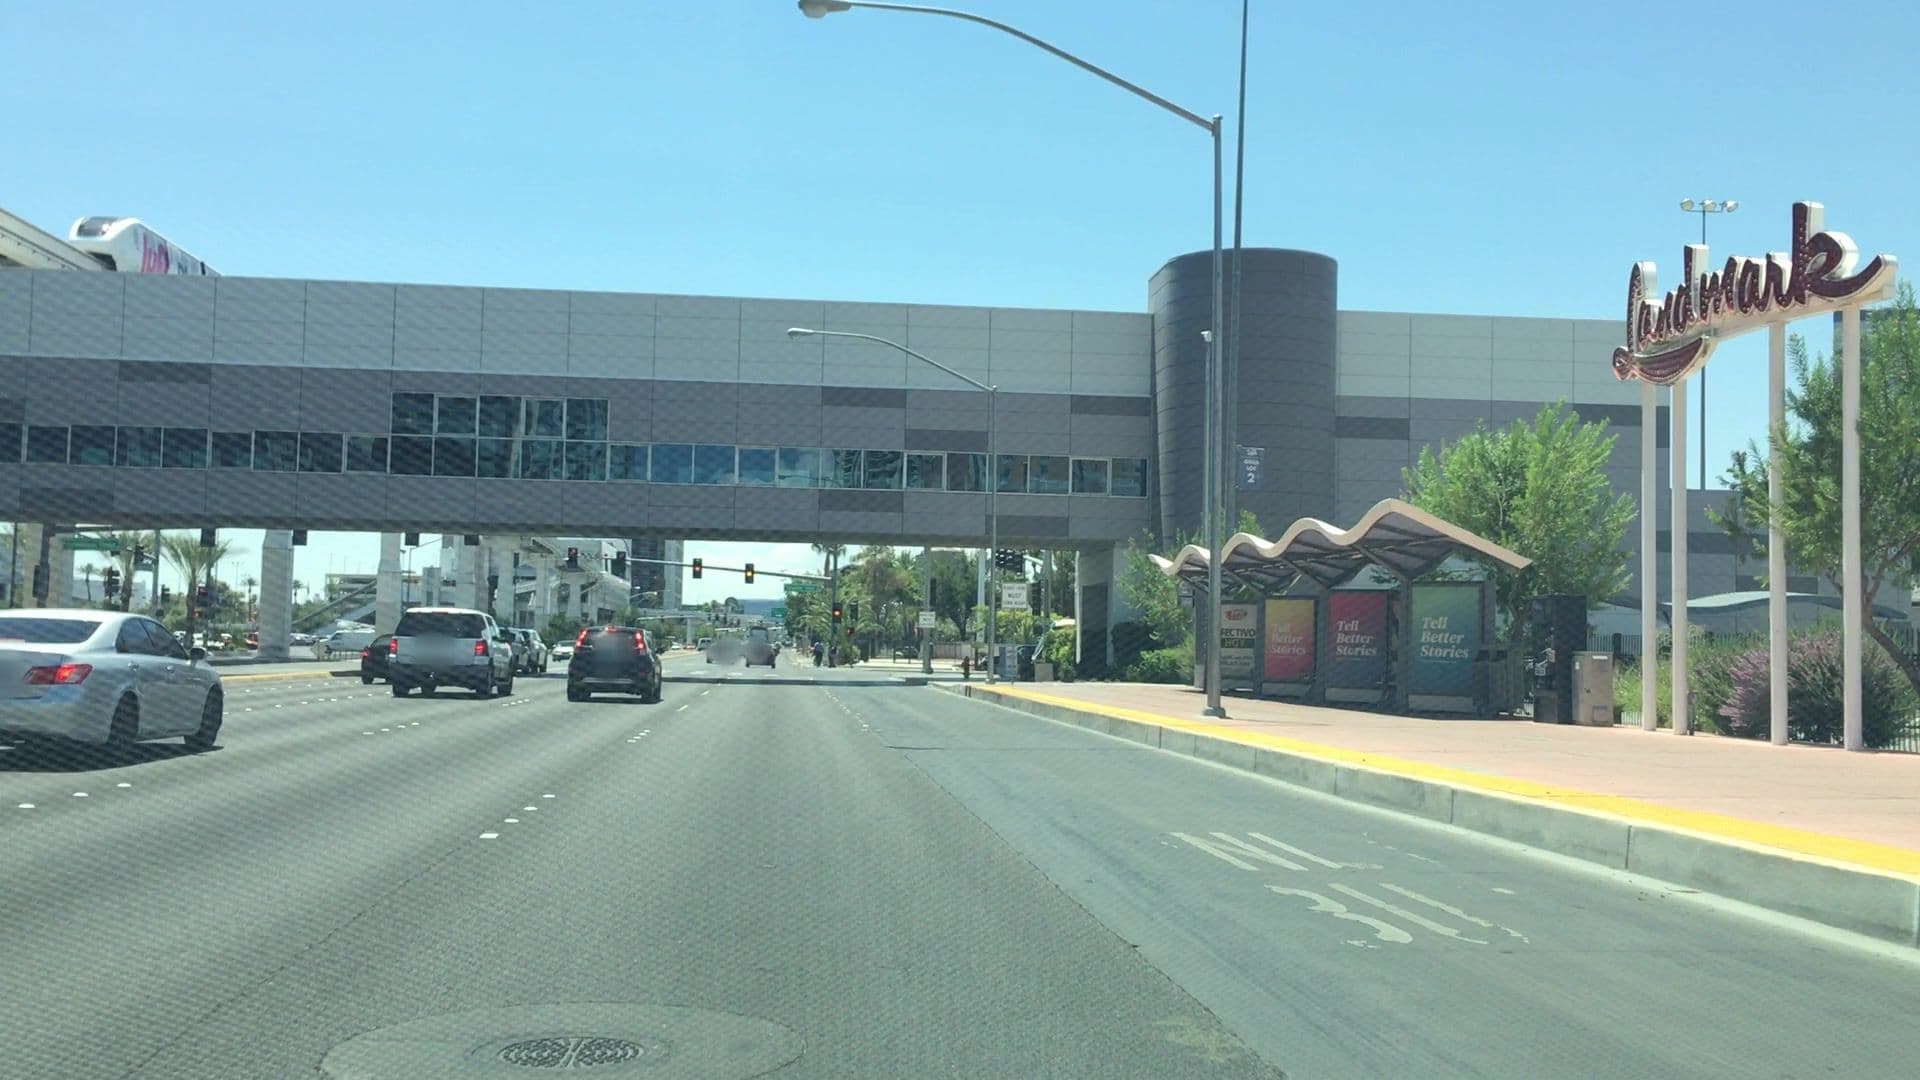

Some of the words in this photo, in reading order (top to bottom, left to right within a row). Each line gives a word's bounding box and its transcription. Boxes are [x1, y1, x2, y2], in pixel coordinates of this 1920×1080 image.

[1247, 472, 1256, 483] 2
[1336, 620, 1359, 631] Tell
[1421, 617, 1448, 629] Tell
[1221, 628, 1256, 638] FECTIVO
[1271, 633, 1305, 644] Better
[1336, 632, 1374, 644] Better
[1420, 631, 1464, 644] Better
[1271, 644, 1307, 656] Stories
[1336, 644, 1378, 656] Stories
[1420, 645, 1469, 659] Stories
